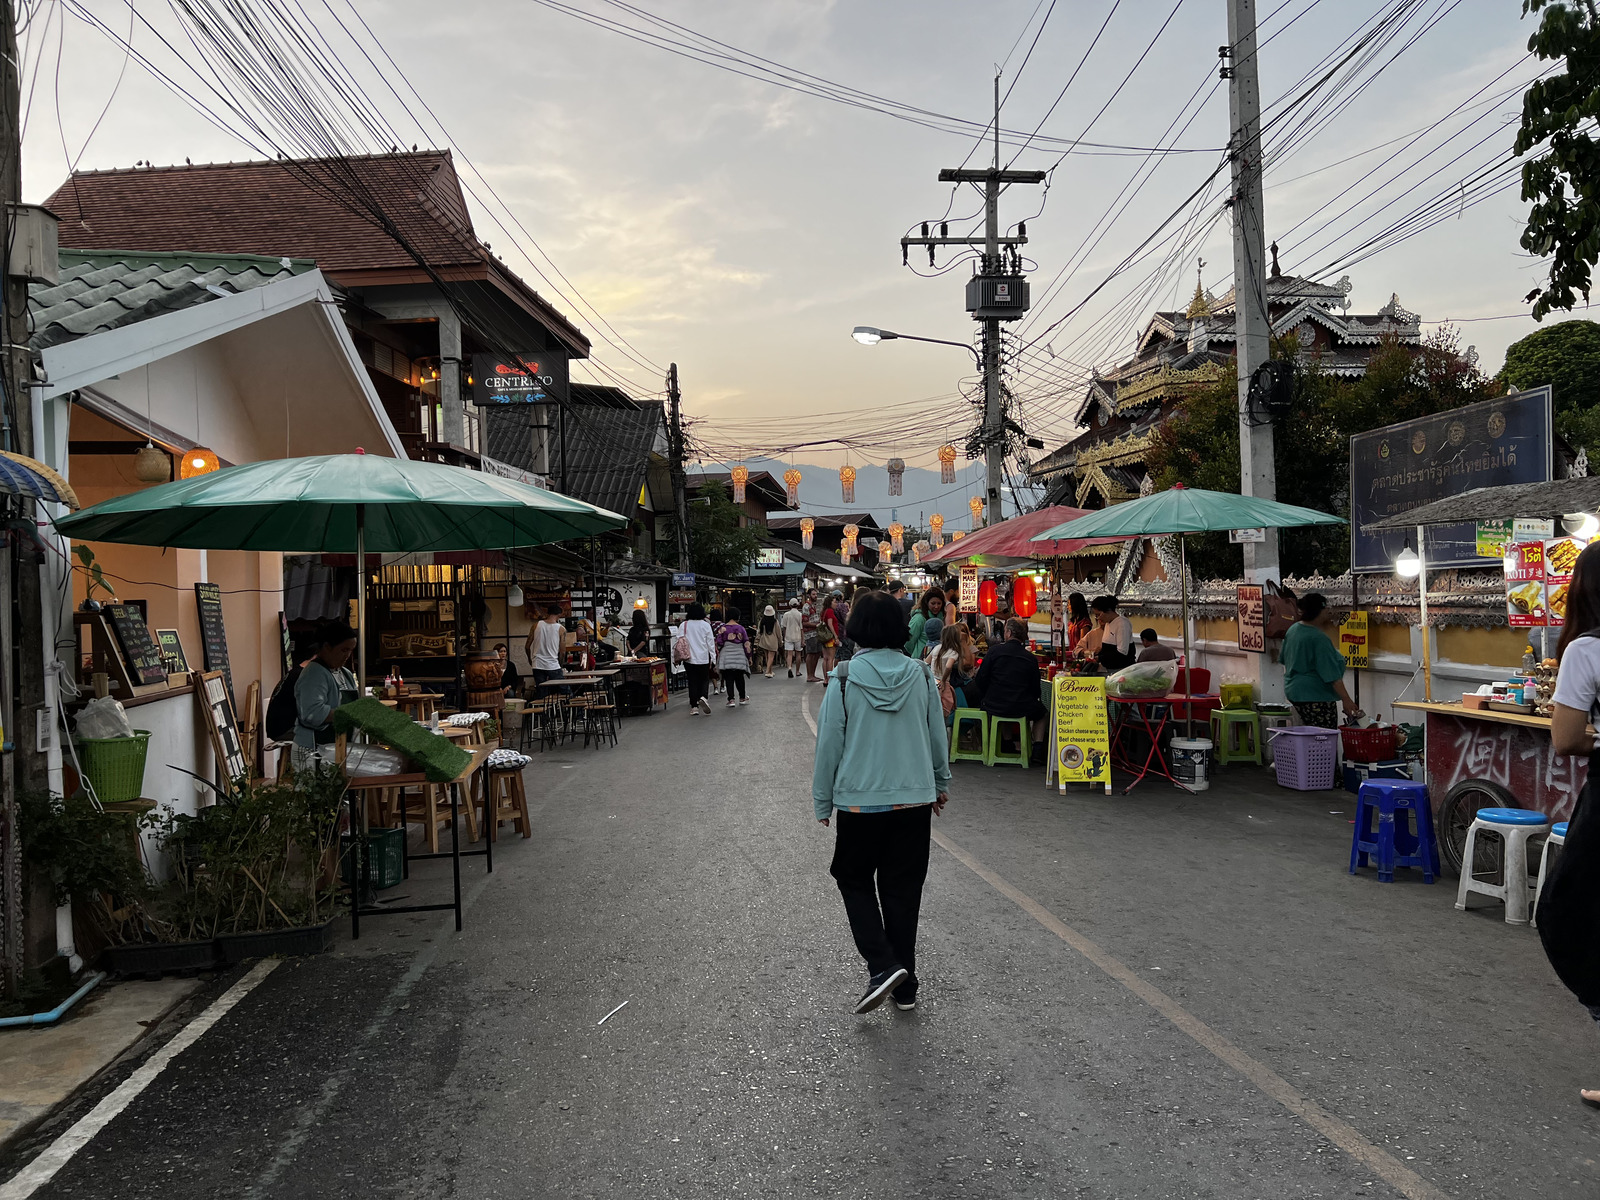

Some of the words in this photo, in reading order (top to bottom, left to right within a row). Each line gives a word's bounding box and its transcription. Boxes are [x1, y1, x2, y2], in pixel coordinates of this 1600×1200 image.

[1522, 547, 1541, 563] โรตี
[1506, 568, 1526, 580] ROTI
[1348, 645, 1359, 655] 081
[1060, 679, 1100, 693] Berrito
[1057, 694, 1077, 702] Vegan
[1058, 703, 1089, 711] Vegetable
